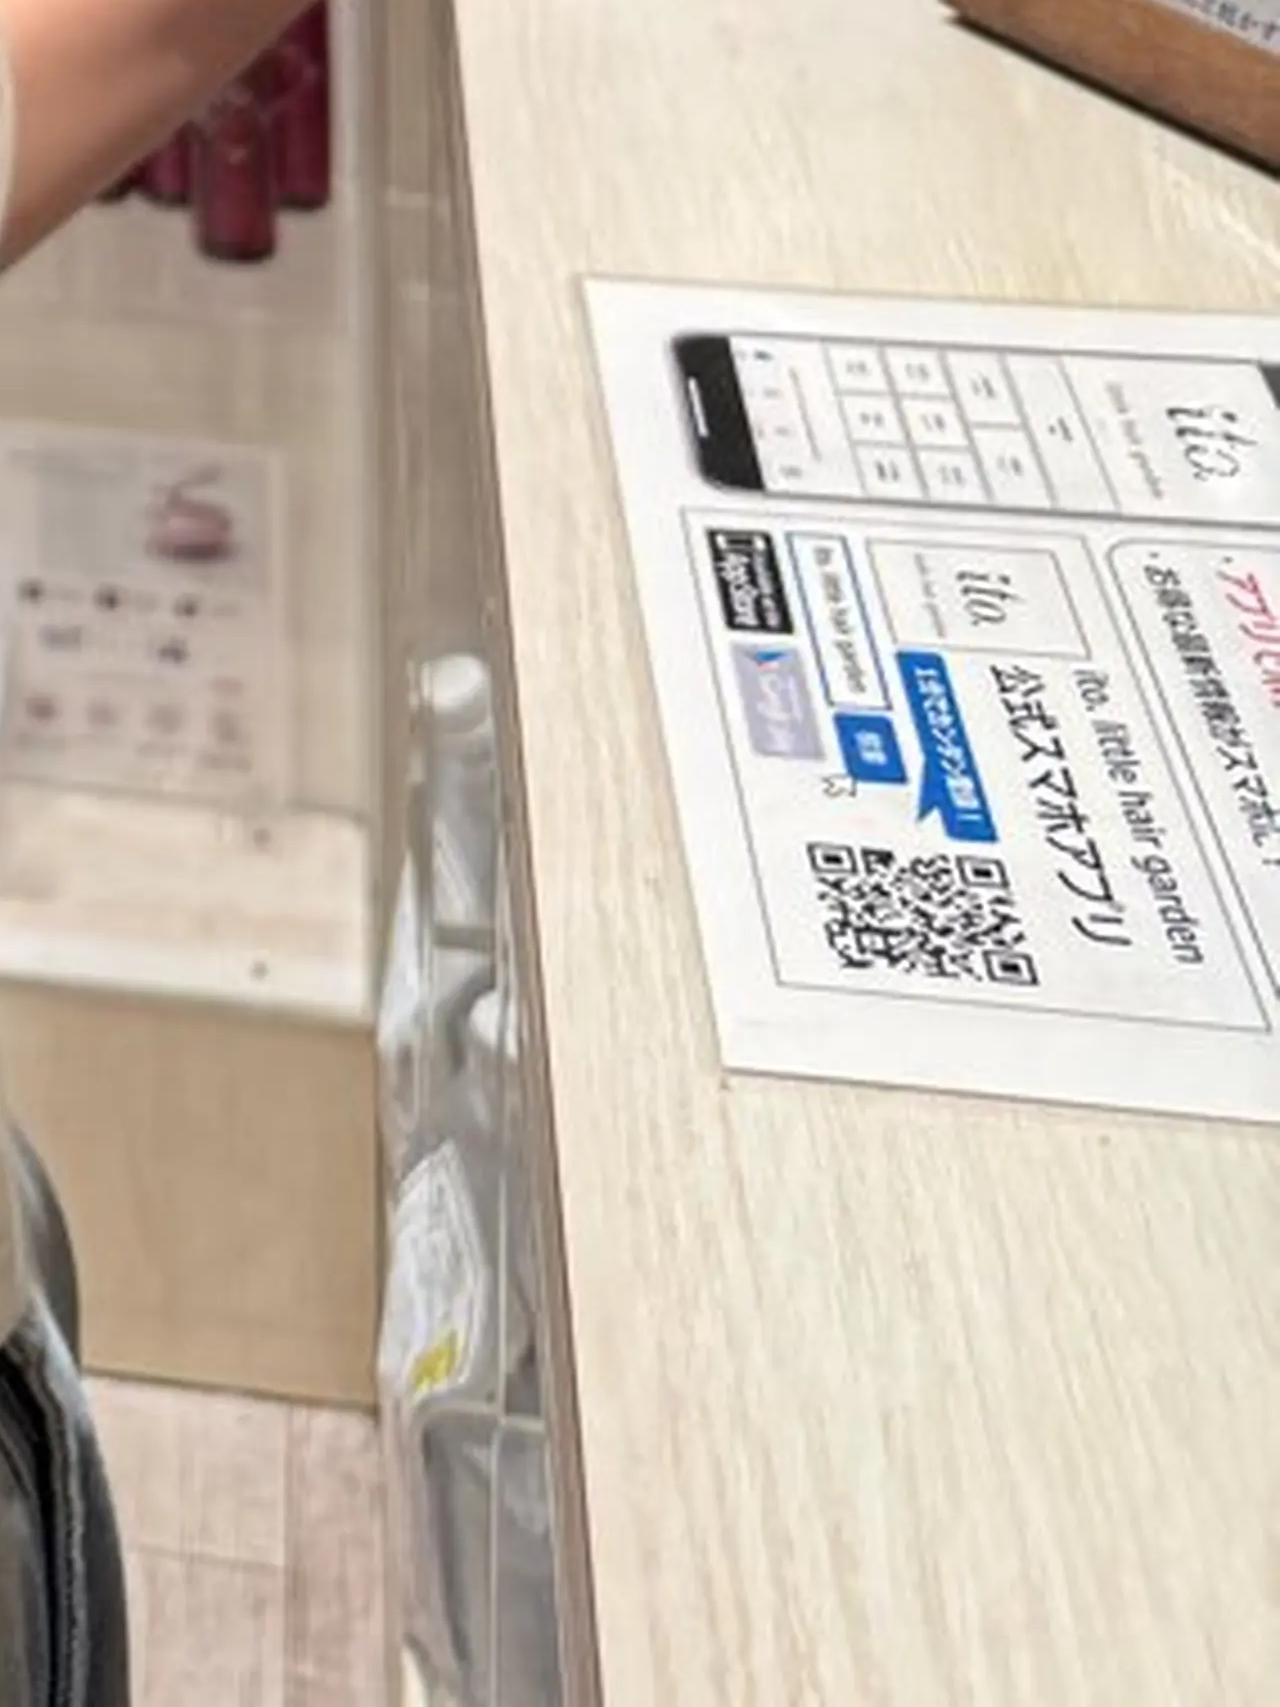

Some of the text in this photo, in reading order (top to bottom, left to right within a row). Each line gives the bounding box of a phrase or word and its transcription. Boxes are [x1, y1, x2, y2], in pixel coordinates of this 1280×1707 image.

[989, 664, 1132, 946] 公式スマホアプリ
[1072, 668, 1205, 964] ito. little hair garden
